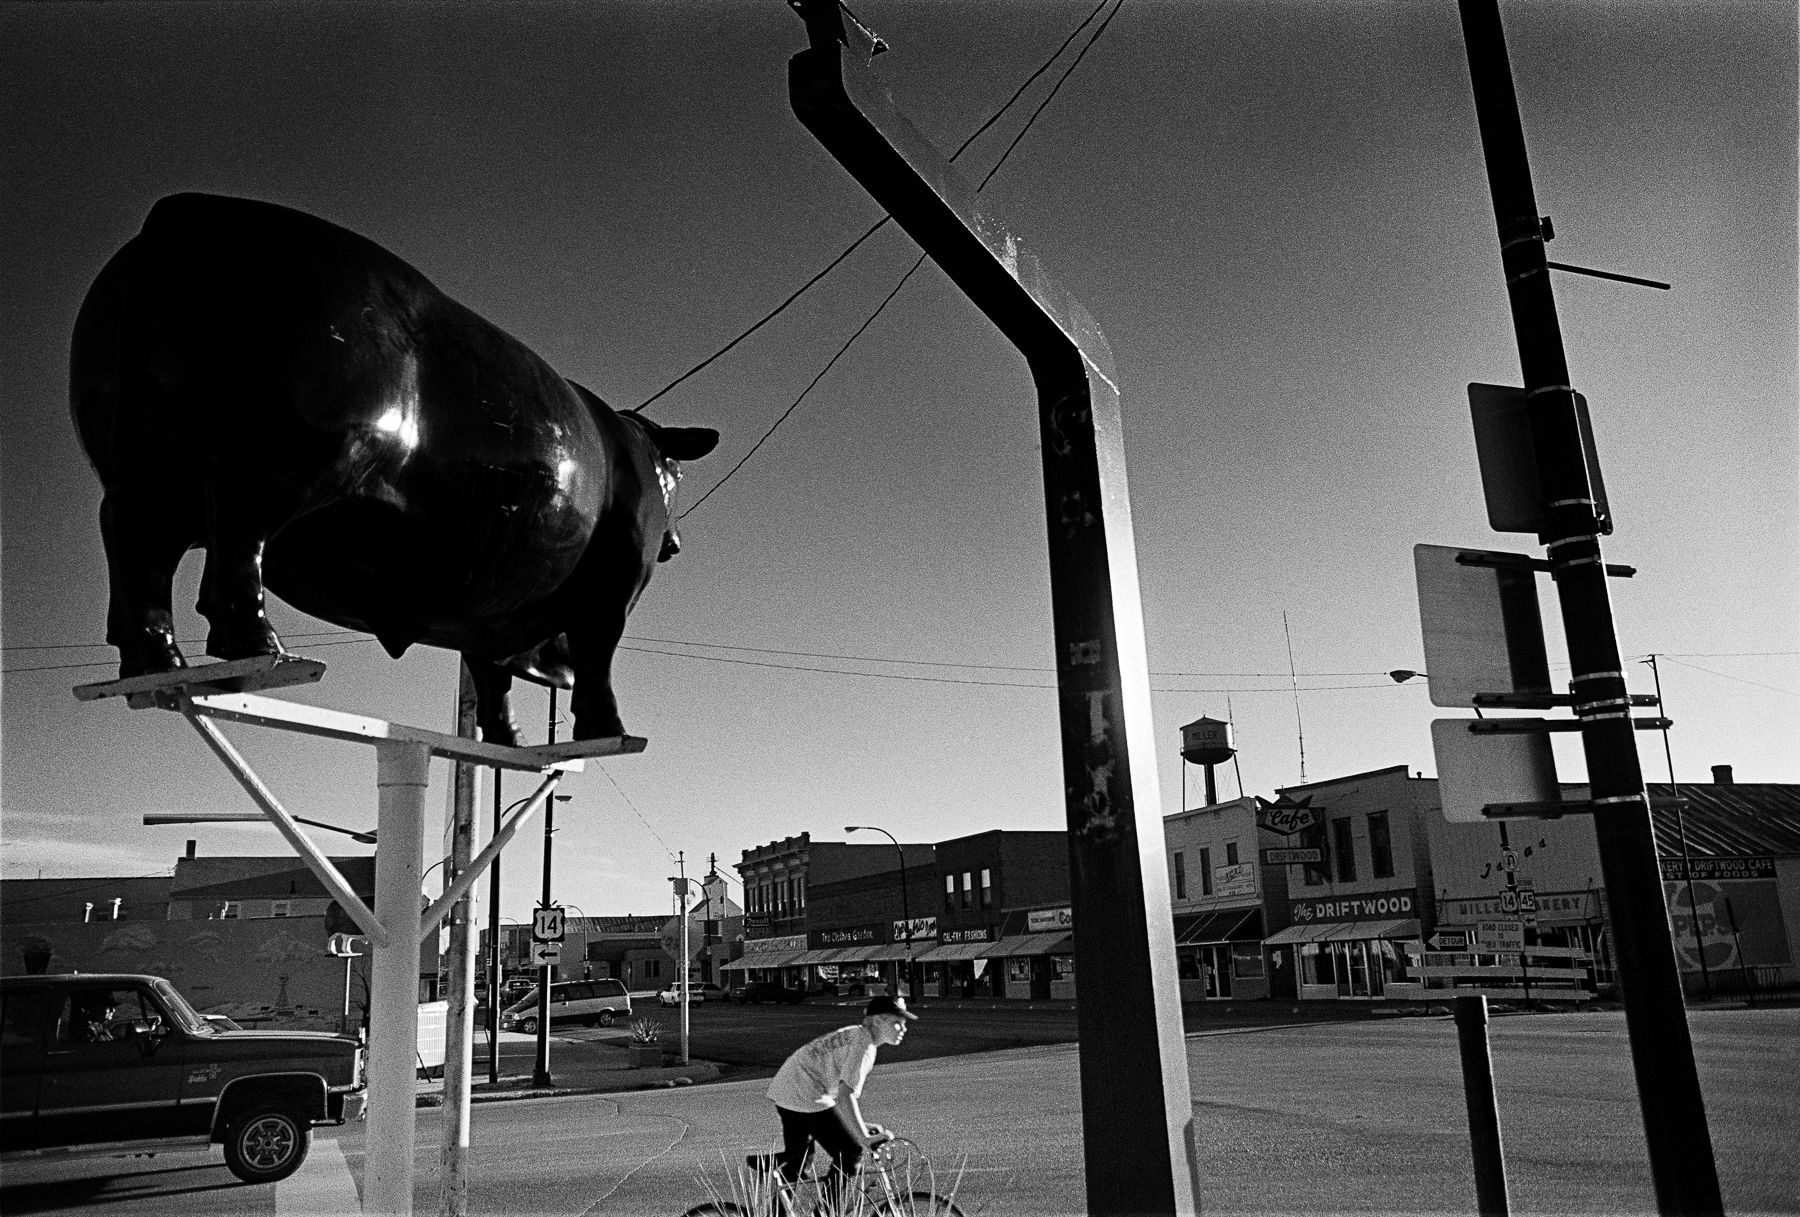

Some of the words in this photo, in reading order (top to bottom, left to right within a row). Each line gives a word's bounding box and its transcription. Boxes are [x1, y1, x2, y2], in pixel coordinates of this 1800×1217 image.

[1192, 730, 1218, 741] MILLER
[1270, 810, 1310, 831] Cafe
[1269, 850, 1319, 862] DRIFTWOOD
[1660, 860, 1684, 872] KERY
[1694, 859, 1746, 872] DRIFTWOOD
[1748, 858, 1773, 870] CAFE
[1714, 871, 1760, 879] FOODS
[1315, 896, 1412, 918] DRIFTWOOD
[1459, 900, 1501, 915] MILLE
[1536, 897, 1581, 911] AKERY
[1503, 894, 1515, 907] 14
[1521, 894, 1534, 907] 45
[541, 915, 558, 935] 14
[1497, 923, 1519, 932] CLOSED
[1439, 936, 1464, 946] DETOUR
[1499, 940, 1522, 949] TRAFFIC
